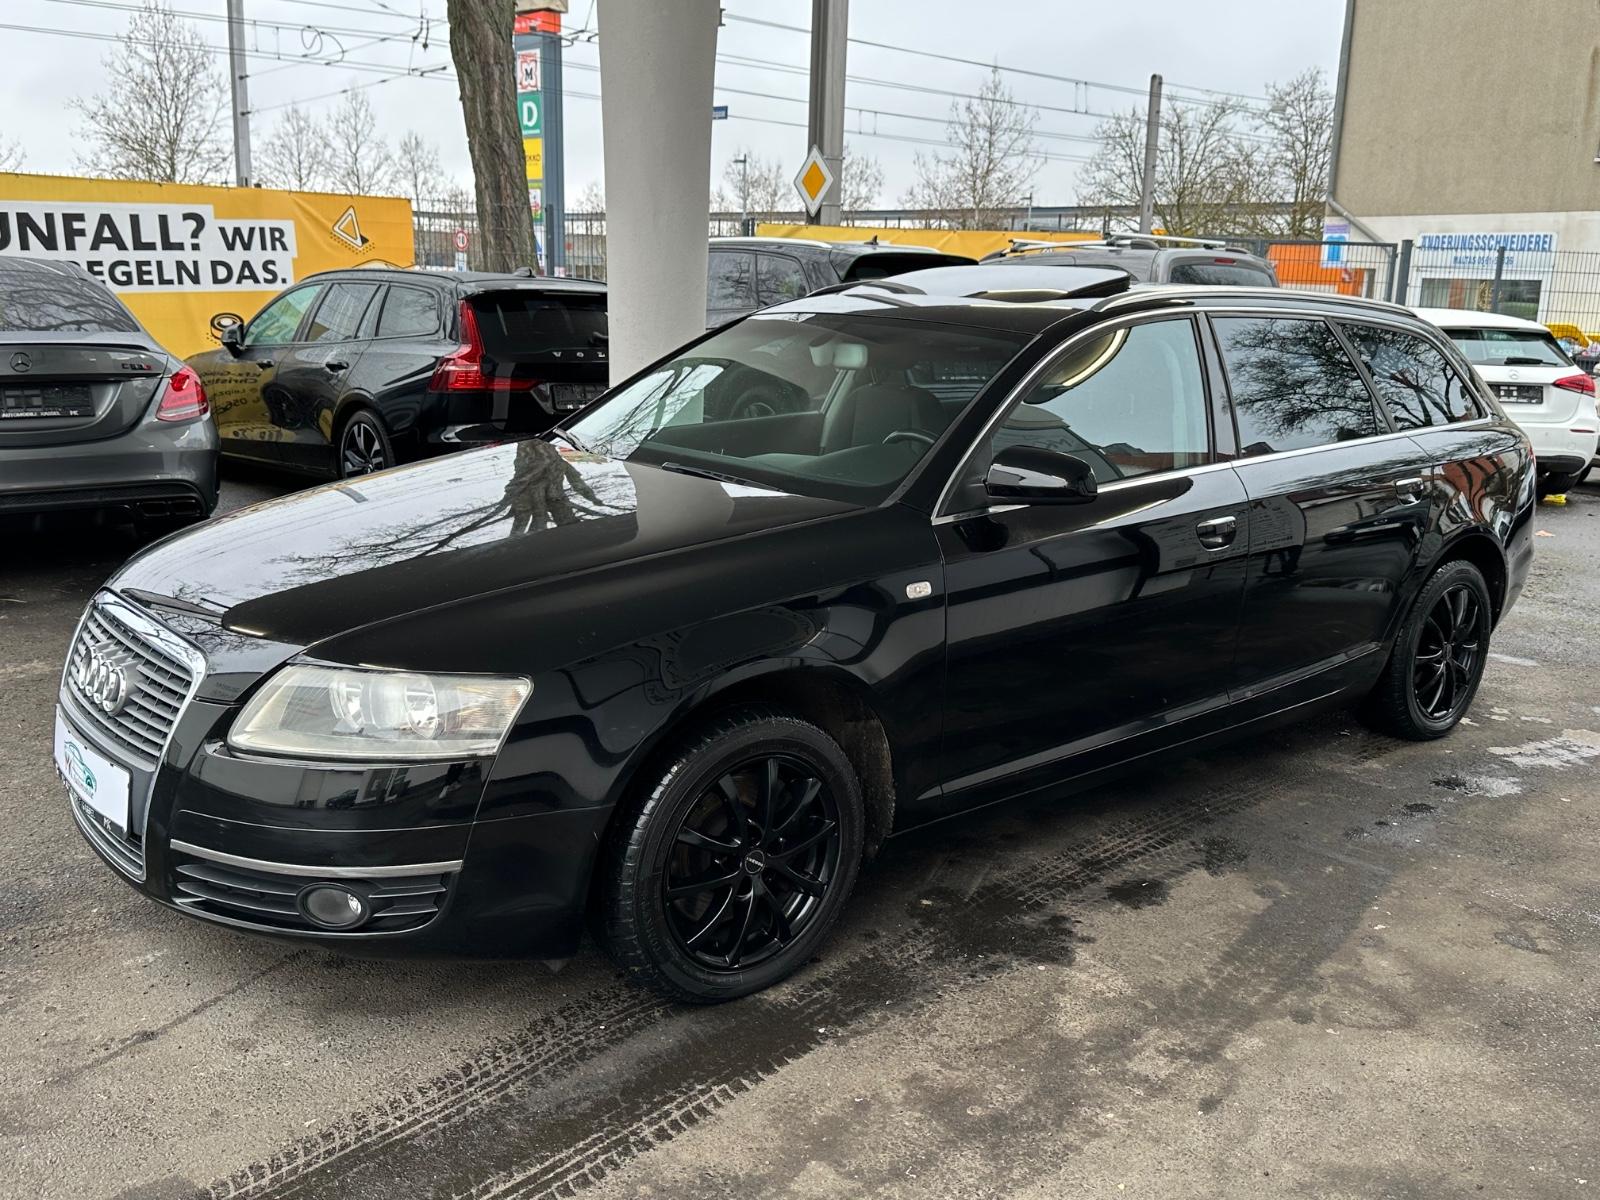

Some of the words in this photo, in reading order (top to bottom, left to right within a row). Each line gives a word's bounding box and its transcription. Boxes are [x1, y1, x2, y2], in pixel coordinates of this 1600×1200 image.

[522, 102, 538, 128] D
[218, 226, 289, 252] WIR
[66, 259, 201, 286] EGELN
[210, 260, 288, 286] DAS.
